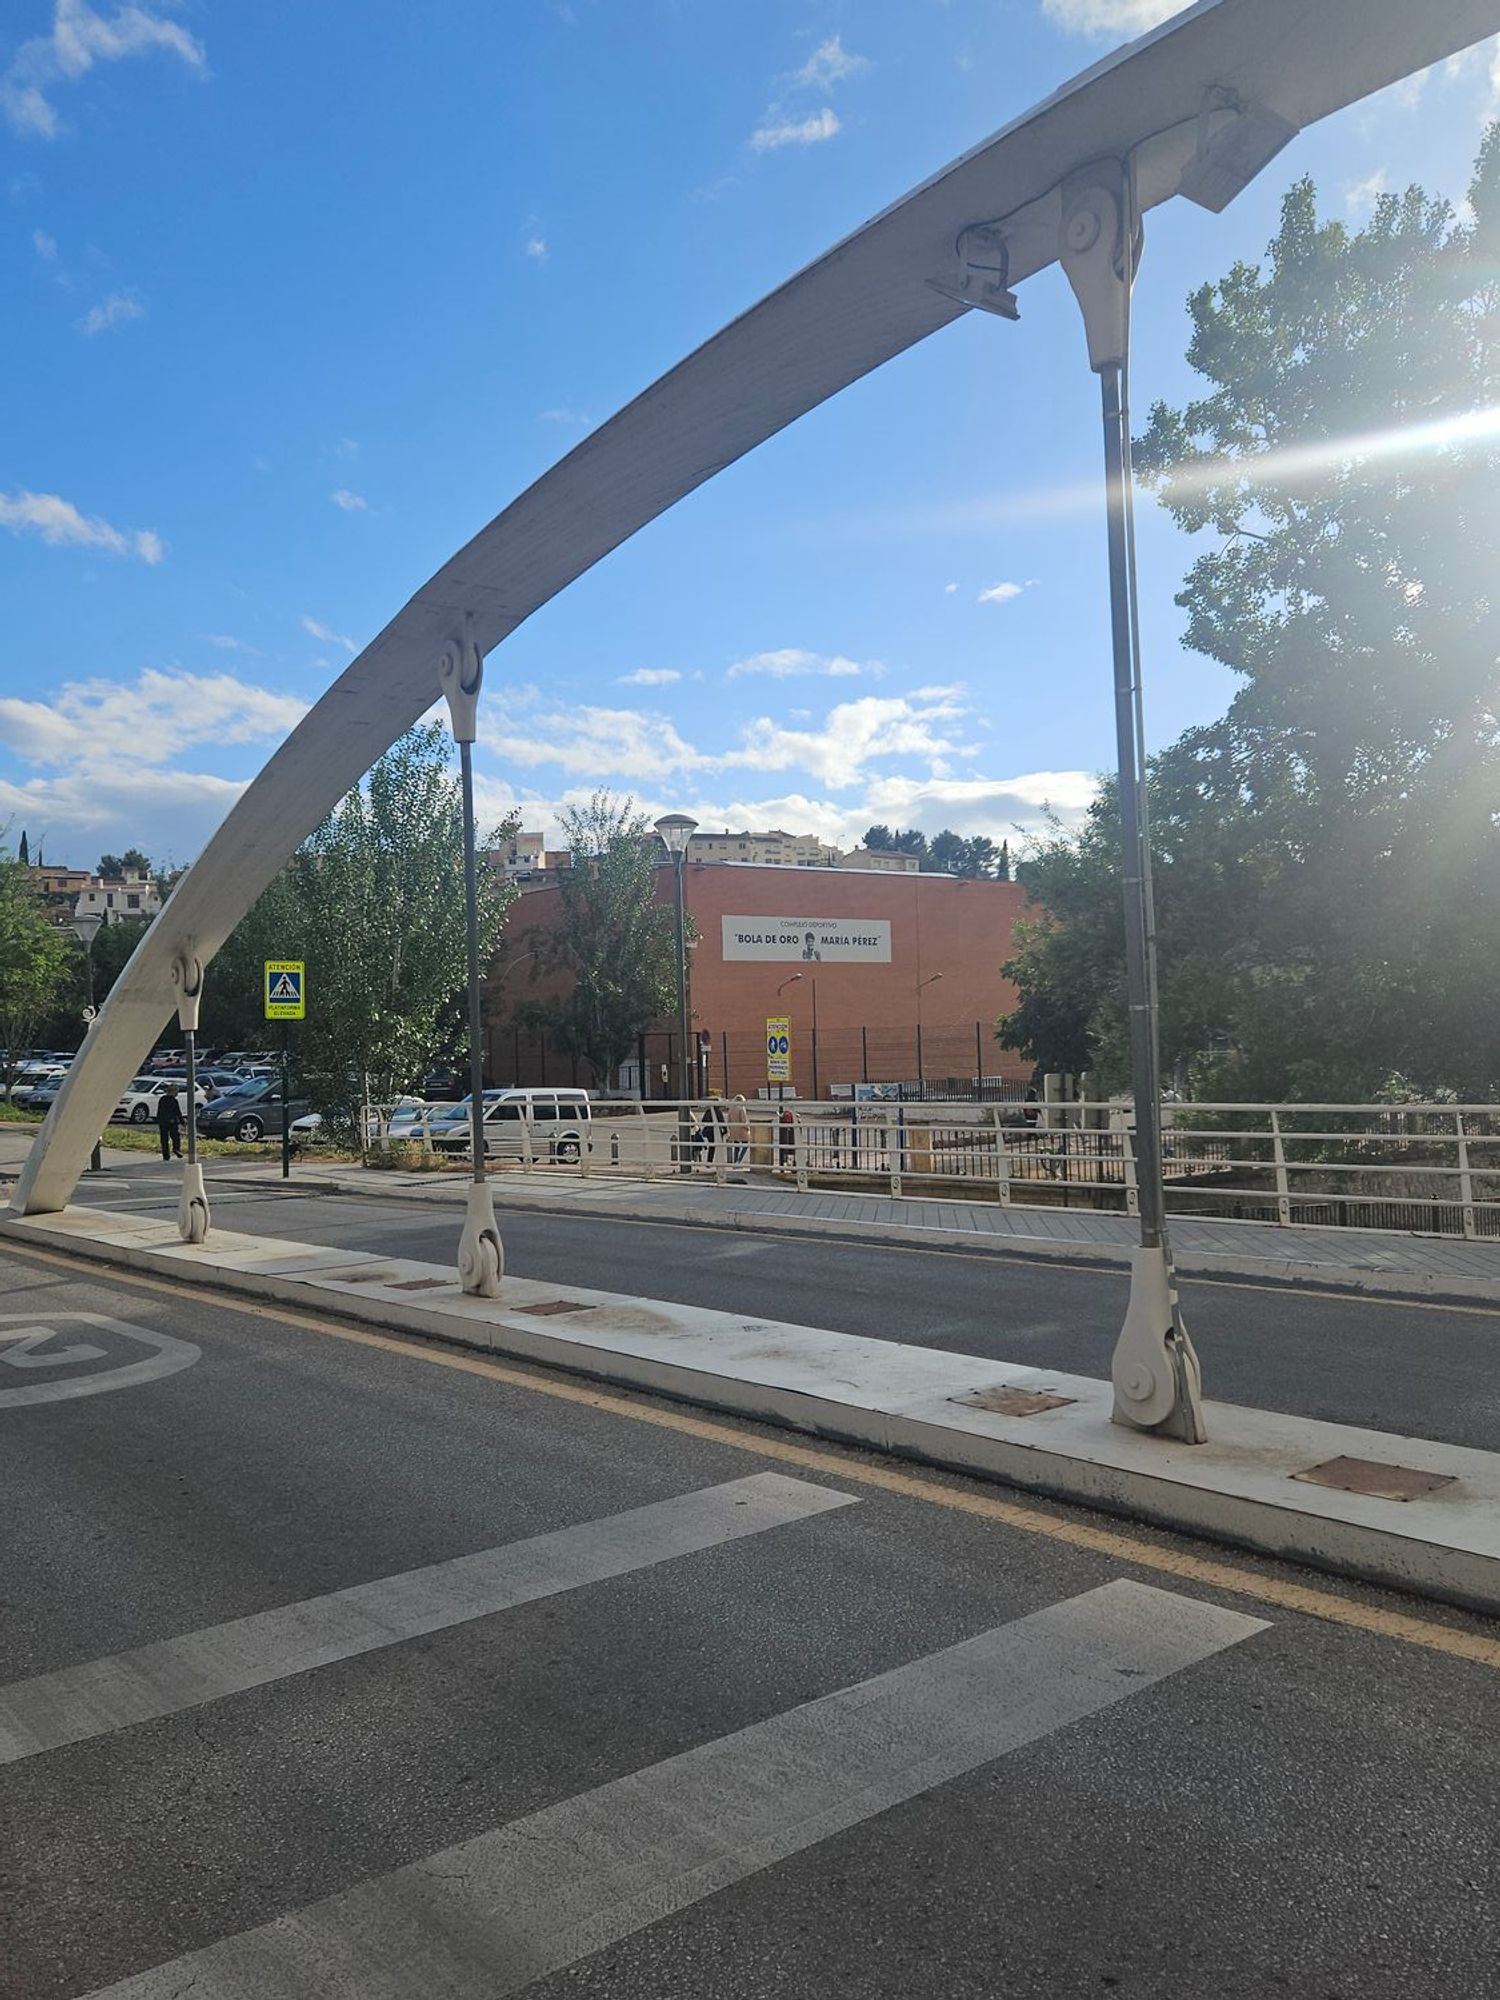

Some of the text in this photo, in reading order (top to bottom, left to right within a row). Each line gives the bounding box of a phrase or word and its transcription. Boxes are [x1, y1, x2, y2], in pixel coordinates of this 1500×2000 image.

[734, 933, 763, 944] "BOLA
[765, 934, 777, 944] DE
[779, 935, 799, 944] ORO
